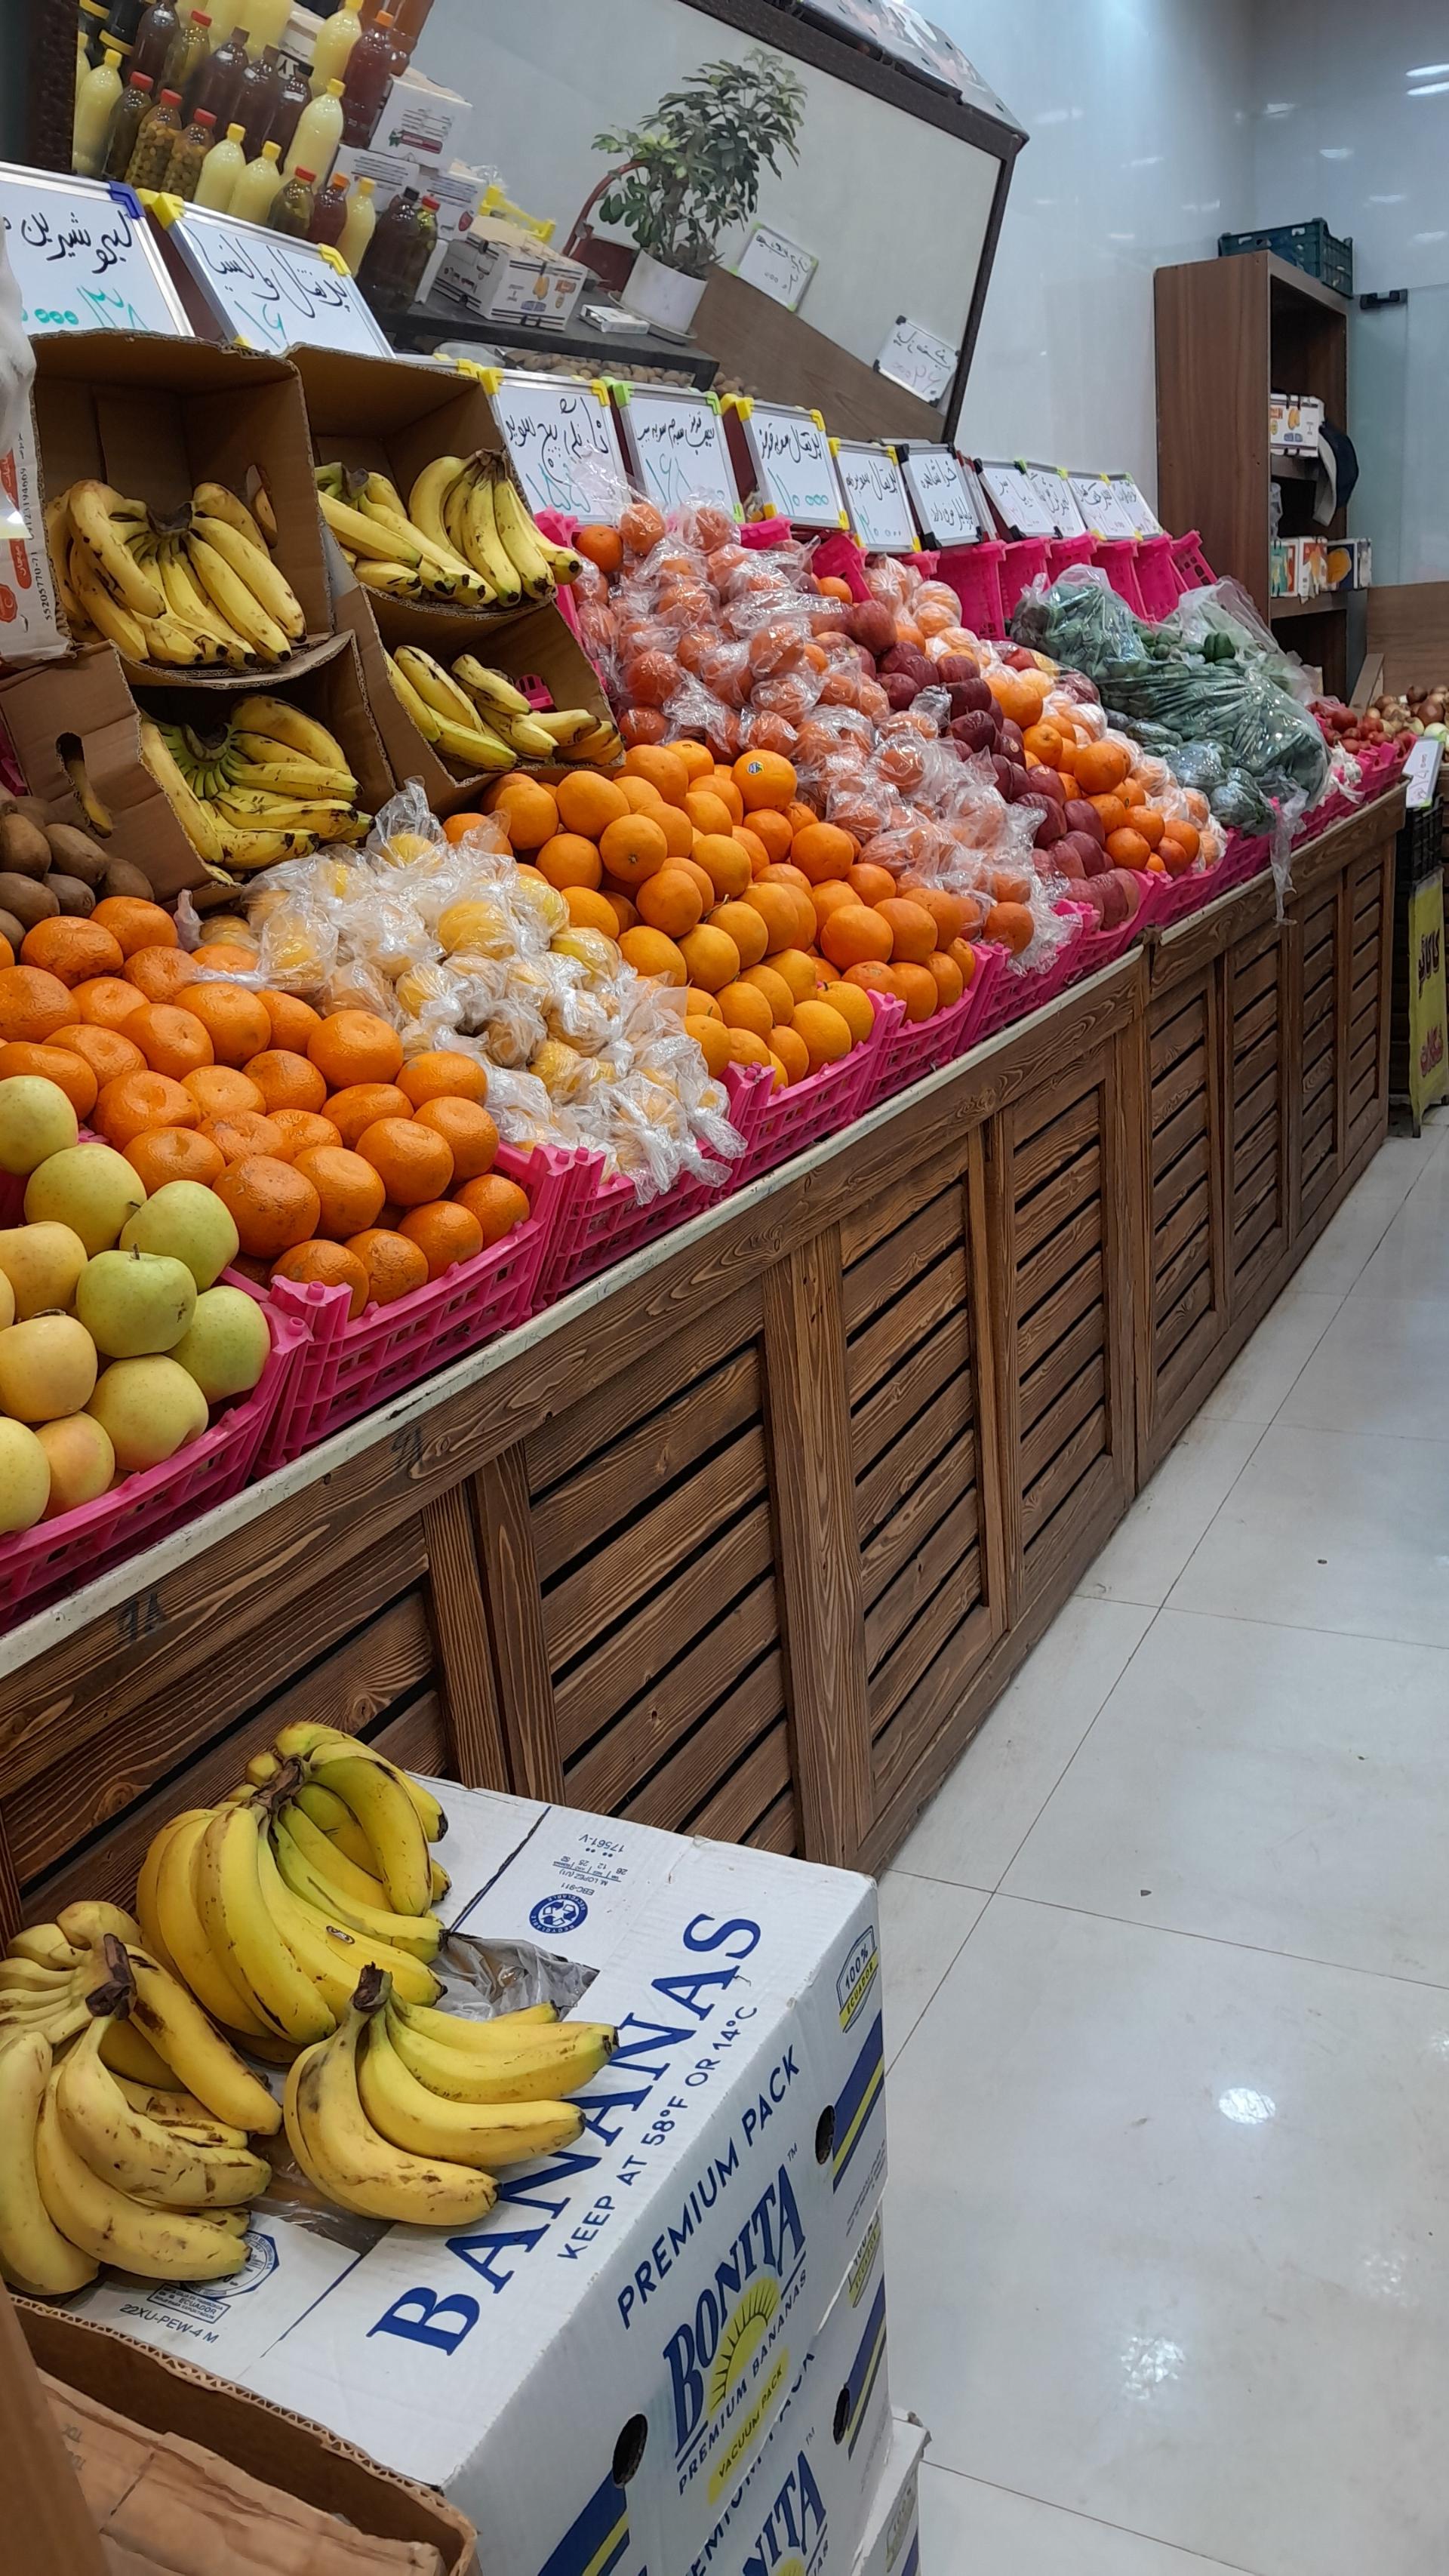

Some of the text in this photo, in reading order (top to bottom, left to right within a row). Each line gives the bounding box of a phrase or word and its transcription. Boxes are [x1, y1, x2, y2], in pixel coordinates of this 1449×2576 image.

[844, 1943, 869, 1990] 100%
[846, 1962, 874, 2015] ECUADOR
[367, 1912, 761, 2356] BANANAS
[557, 2196, 616, 2260] KEEP
[617, 2154, 647, 2186] AT
[685, 2058, 721, 2087] OR
[617, 2044, 801, 2330] PREMIUM PACK
[662, 2163, 807, 2459] BONITA
[678, 2377, 748, 2497] PREMIUM
[752, 2268, 807, 2378] BANANAS
[718, 2410, 761, 2479] VACUUM
[761, 2364, 783, 2410] PACK
